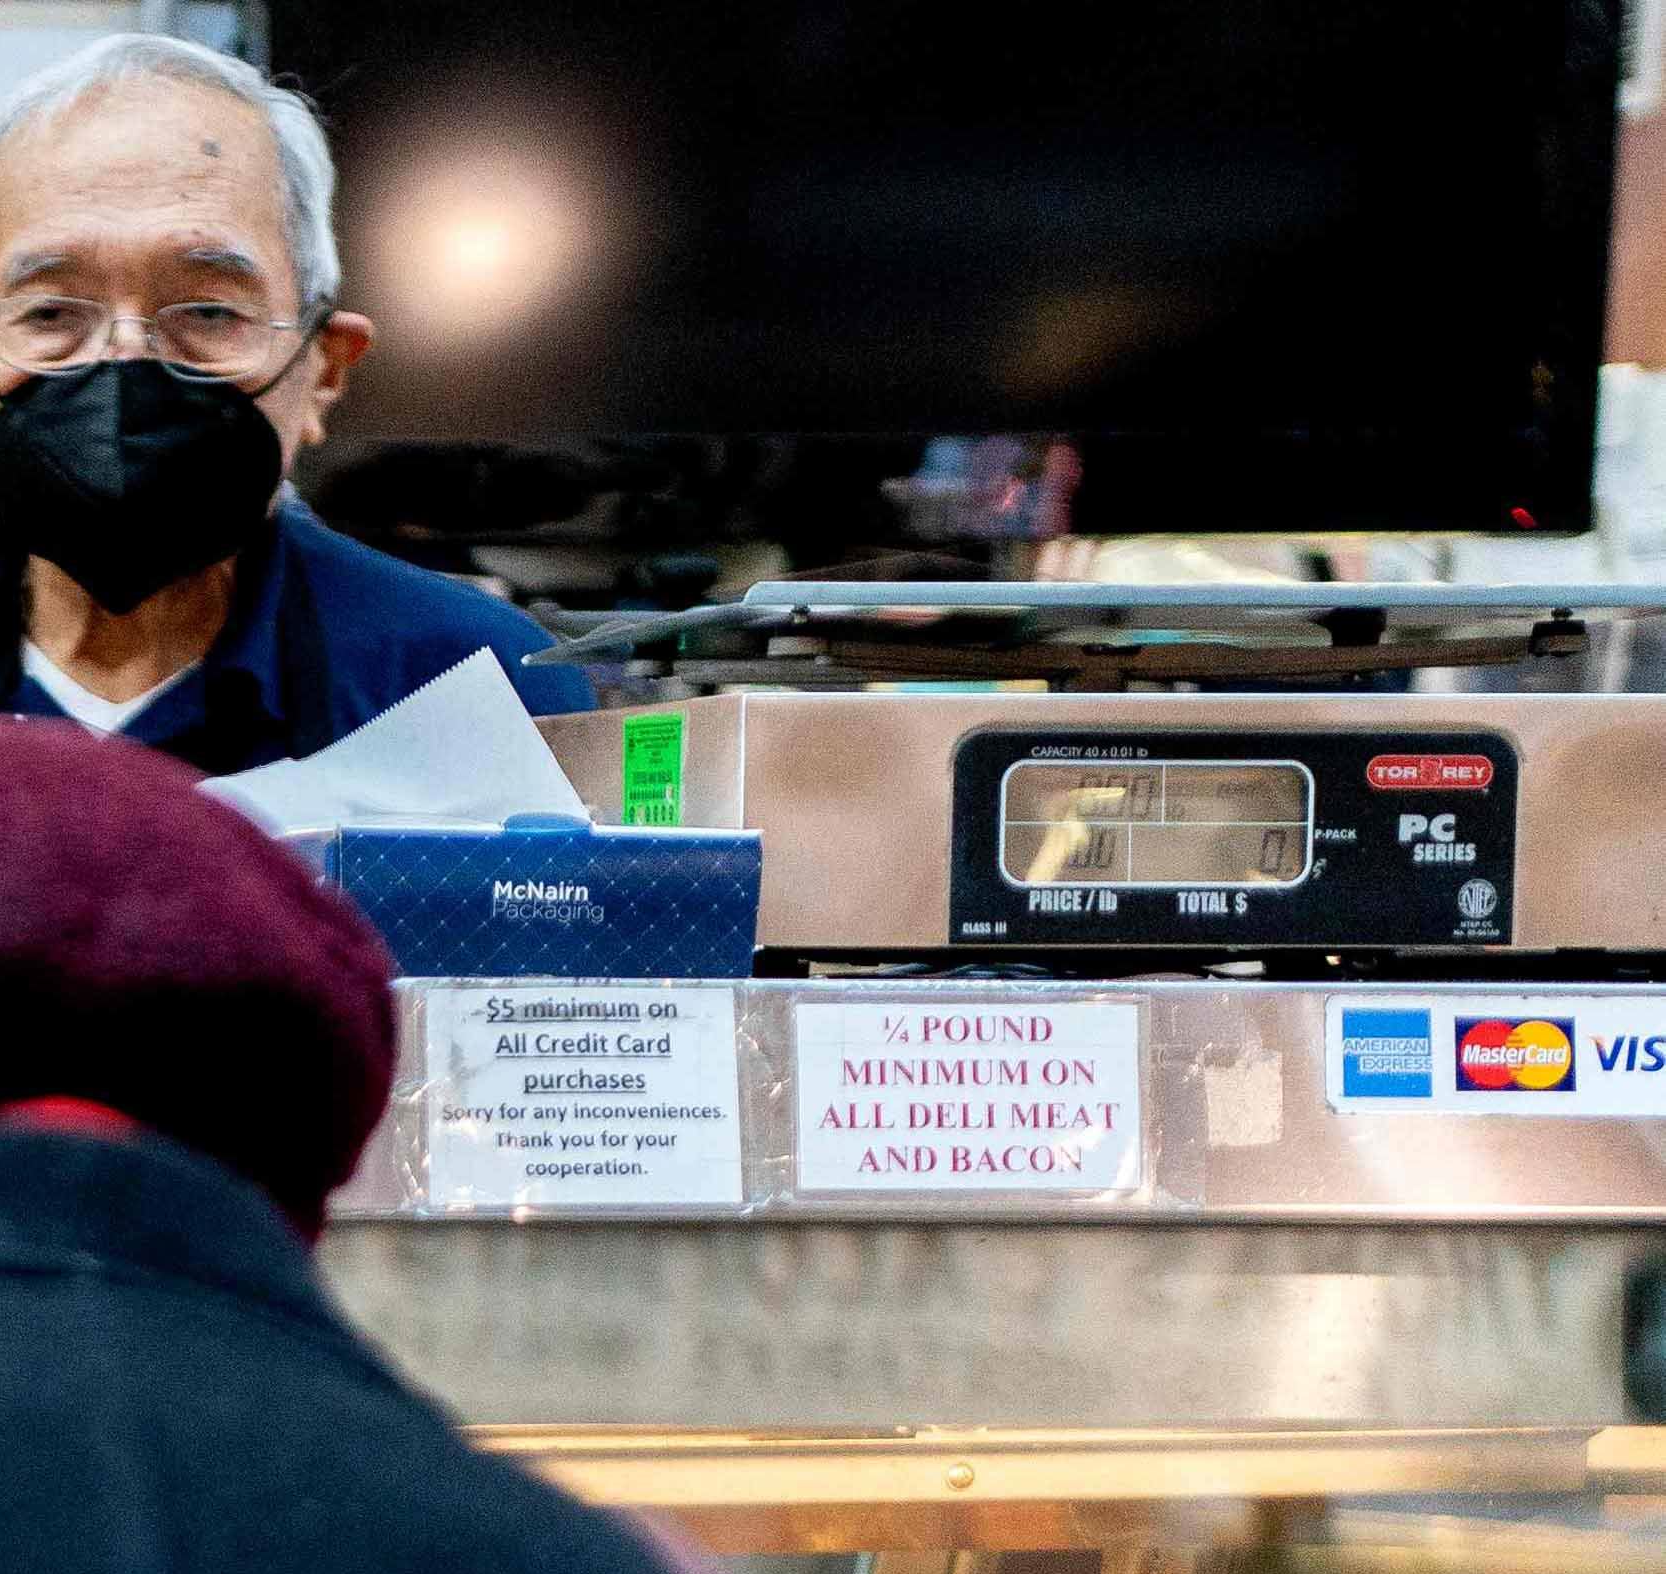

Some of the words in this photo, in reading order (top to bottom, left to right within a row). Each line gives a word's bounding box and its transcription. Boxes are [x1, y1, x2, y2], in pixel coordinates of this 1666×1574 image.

[1031, 746, 1083, 758] CAPACITY
[1084, 746, 1099, 758] 40
[1110, 746, 1134, 758] 0.01
[1314, 827, 1358, 840] P-PACK
[1398, 813, 1456, 843] PC
[1412, 843, 1477, 863] SERIES
[493, 880, 589, 902] McNairn
[1029, 890, 1082, 913] PRICE
[1097, 890, 1118, 913] lb
[1177, 891, 1231, 914] TOTAL
[493, 900, 605, 924] Packaging
[962, 922, 993, 936] CLASS
[485, 996, 516, 1021] $5
[523, 996, 641, 1020] minimum
[647, 1001, 678, 1019] on
[921, 1015, 1054, 1043] POUND
[495, 1033, 527, 1055] All
[535, 1033, 609, 1055] Credit
[616, 1033, 672, 1055] Card
[1343, 1038, 1428, 1054] AMERICAN
[1462, 1043, 1568, 1067] MasterCard
[841, 1059, 1030, 1087] MINIMUM
[1041, 1058, 1097, 1086] ON
[1361, 1056, 1433, 1071] EXPRESS
[523, 1068, 647, 1093] purchases
[442, 1104, 494, 1124] Sorry
[500, 1103, 526, 1120] for
[533, 1106, 567, 1124] any
[573, 1102, 728, 1121] inconveniences.
[819, 1102, 895, 1130] ALL
[908, 1102, 997, 1130] DELI
[1009, 1102, 1120, 1130] MEAT
[495, 1131, 554, 1149] Thank
[558, 1134, 595, 1152] you
[600, 1131, 628, 1149] for
[634, 1134, 678, 1152] your
[524, 1159, 649, 1182] cooperation.
[856, 1145, 939, 1174] AND
[950, 1146, 1084, 1174] BACON
